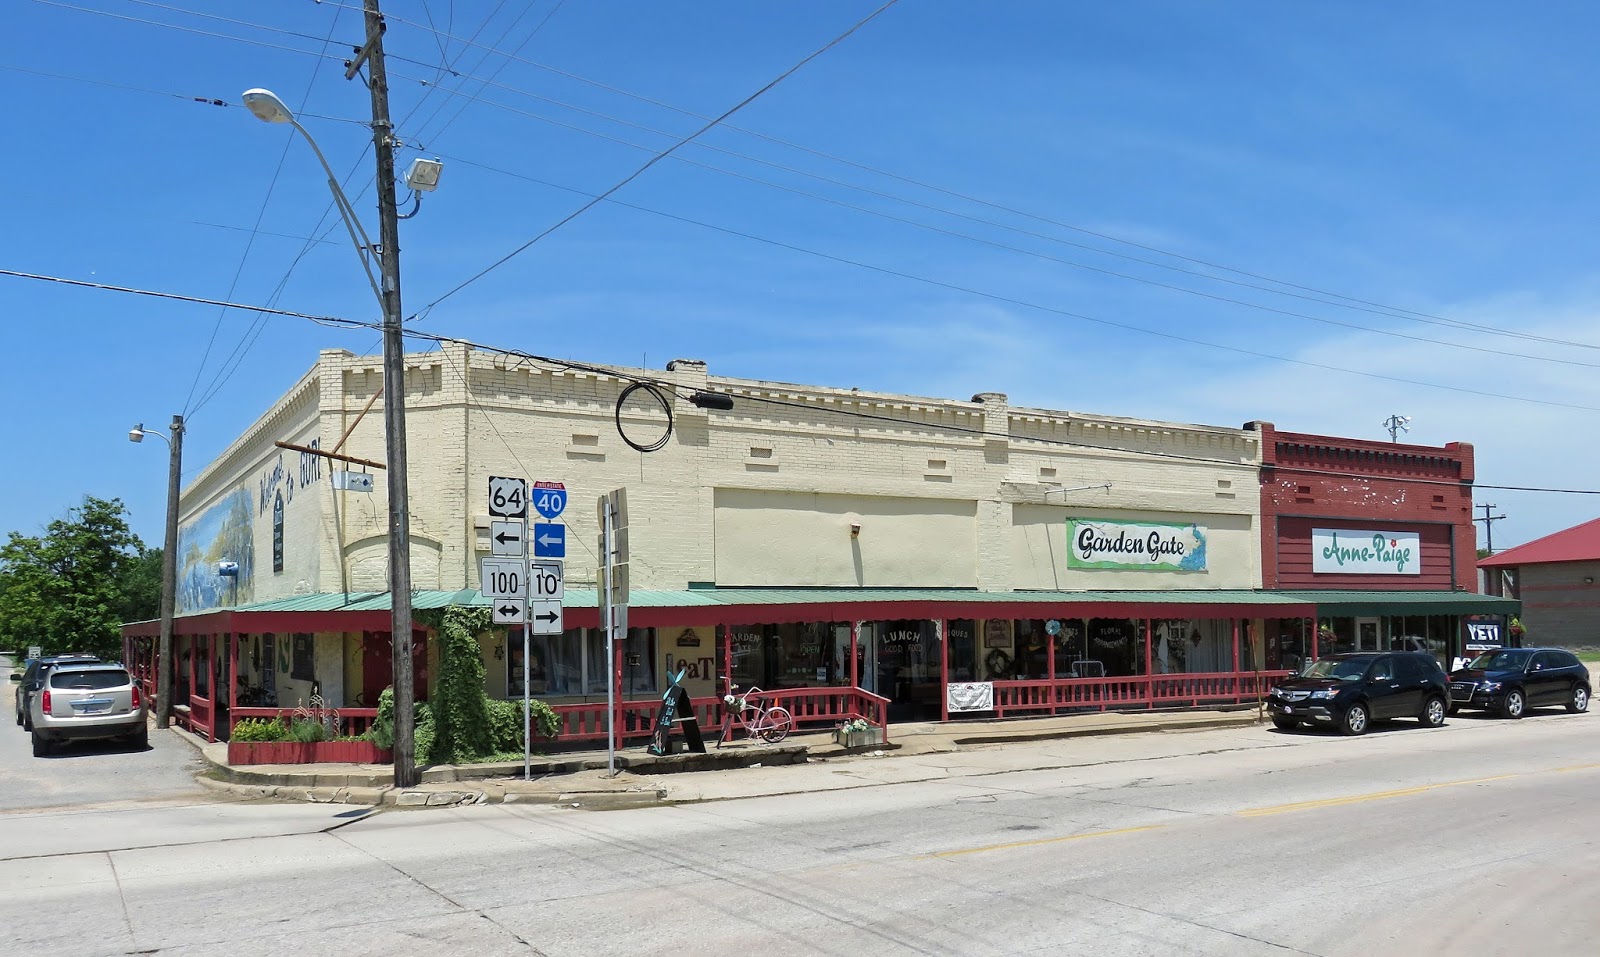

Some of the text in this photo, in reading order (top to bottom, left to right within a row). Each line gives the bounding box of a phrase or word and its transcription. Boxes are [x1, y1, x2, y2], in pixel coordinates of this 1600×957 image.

[493, 486, 521, 508] 64
[537, 494, 562, 513] 40
[1078, 528, 1185, 561] Garden Gate
[1322, 532, 1410, 572] Anne-Paige
[491, 572, 518, 594] 100
[536, 574, 558, 595] 10
[730, 633, 760, 642] ARDEN
[882, 630, 921, 644] LUNCH
[1466, 623, 1499, 640] YETI
